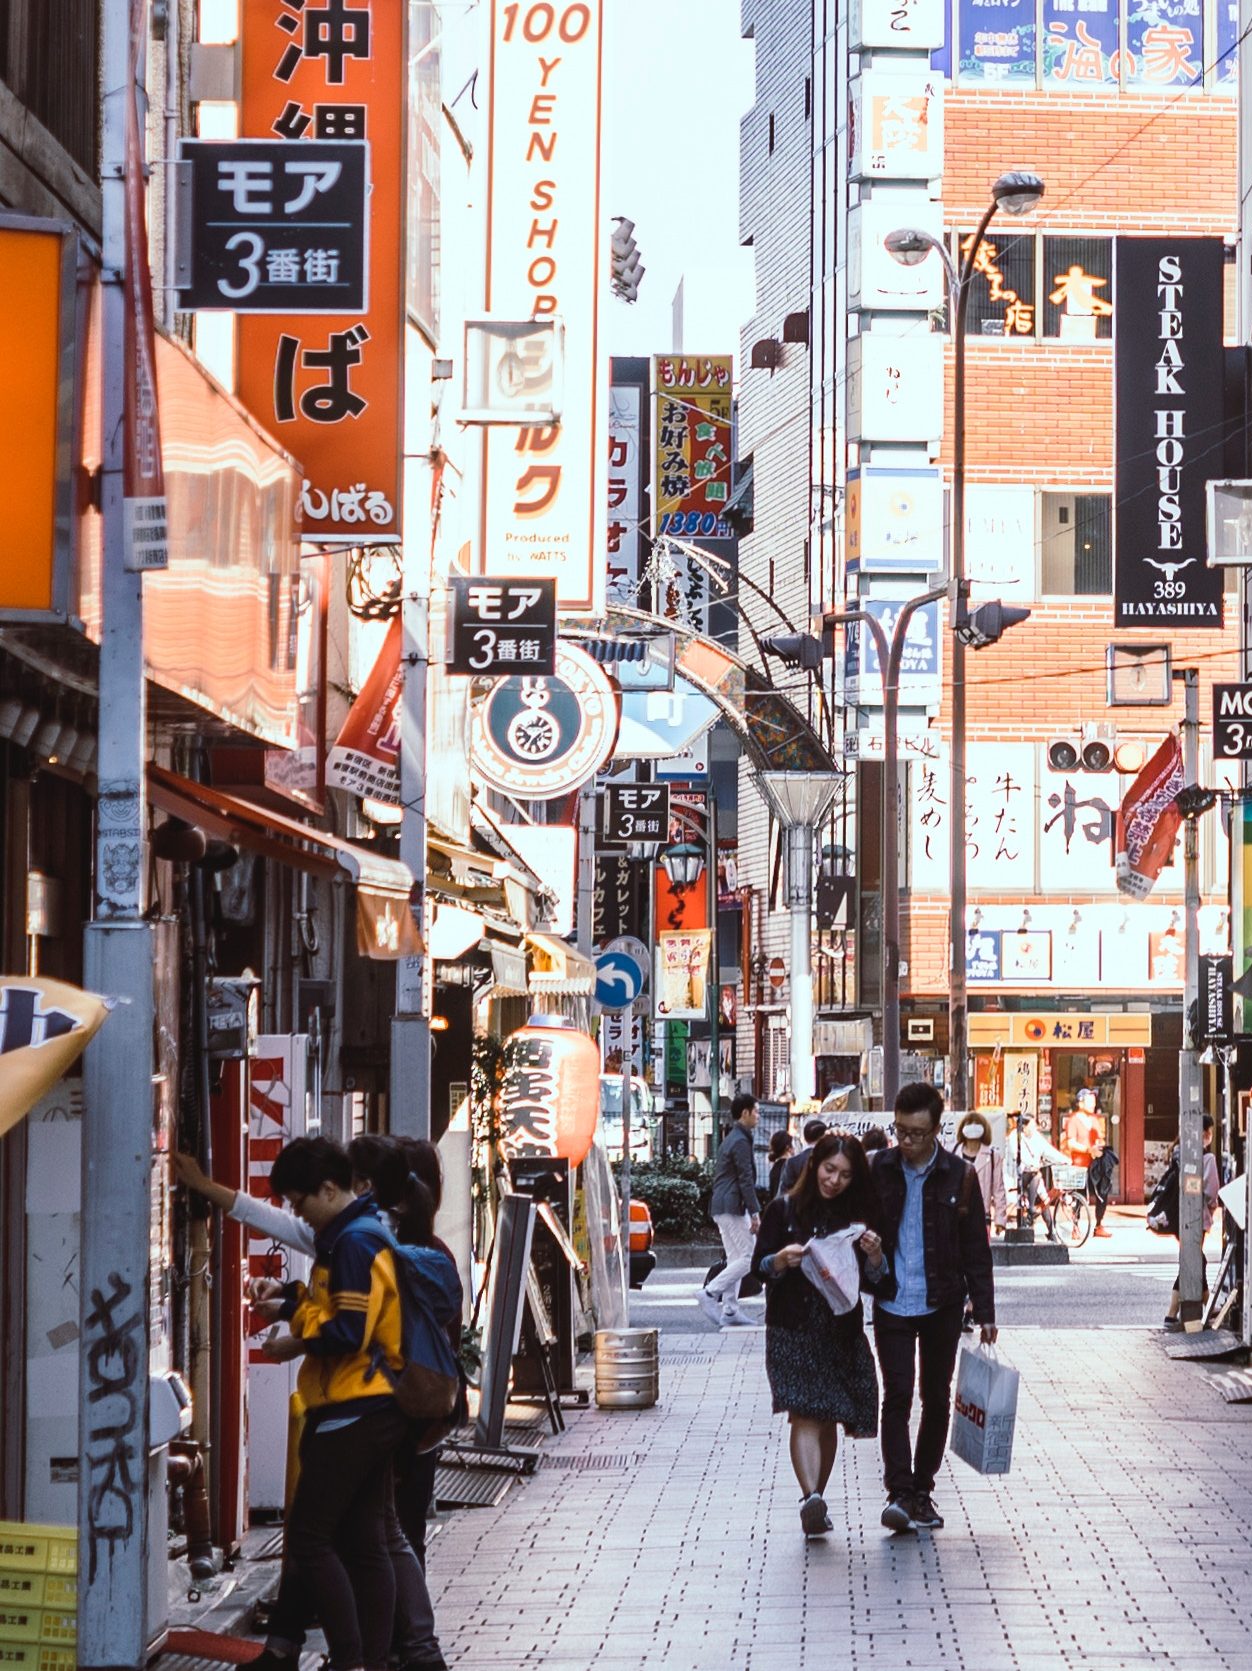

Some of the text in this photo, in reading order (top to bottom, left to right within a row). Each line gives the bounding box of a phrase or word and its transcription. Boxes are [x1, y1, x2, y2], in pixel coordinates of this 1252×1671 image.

[502, 3, 592, 44] 100
[524, 56, 563, 164] YEN
[216, 159, 343, 214] モア
[216, 231, 342, 299] 3番街
[523, 179, 561, 319] SHOP
[658, 358, 730, 389] もんじゃ
[1153, 255, 1186, 551] STEAK HOUSE
[660, 402, 691, 499] お好み焼
[504, 531, 571, 544] Produced
[467, 587, 542, 620] モア
[1120, 601, 1219, 617] HAYASHIYA
[1153, 581, 1187, 599] 389
[468, 629, 541, 670] 3番街
[867, 735, 935, 752] 石ビル
[618, 788, 662, 809] モア
[916, 771, 948, 861] 麦めし
[992, 771, 1022, 862] 牛たん
[618, 813, 660, 838] 3番街
[1052, 1020, 1095, 1040] 松屋
